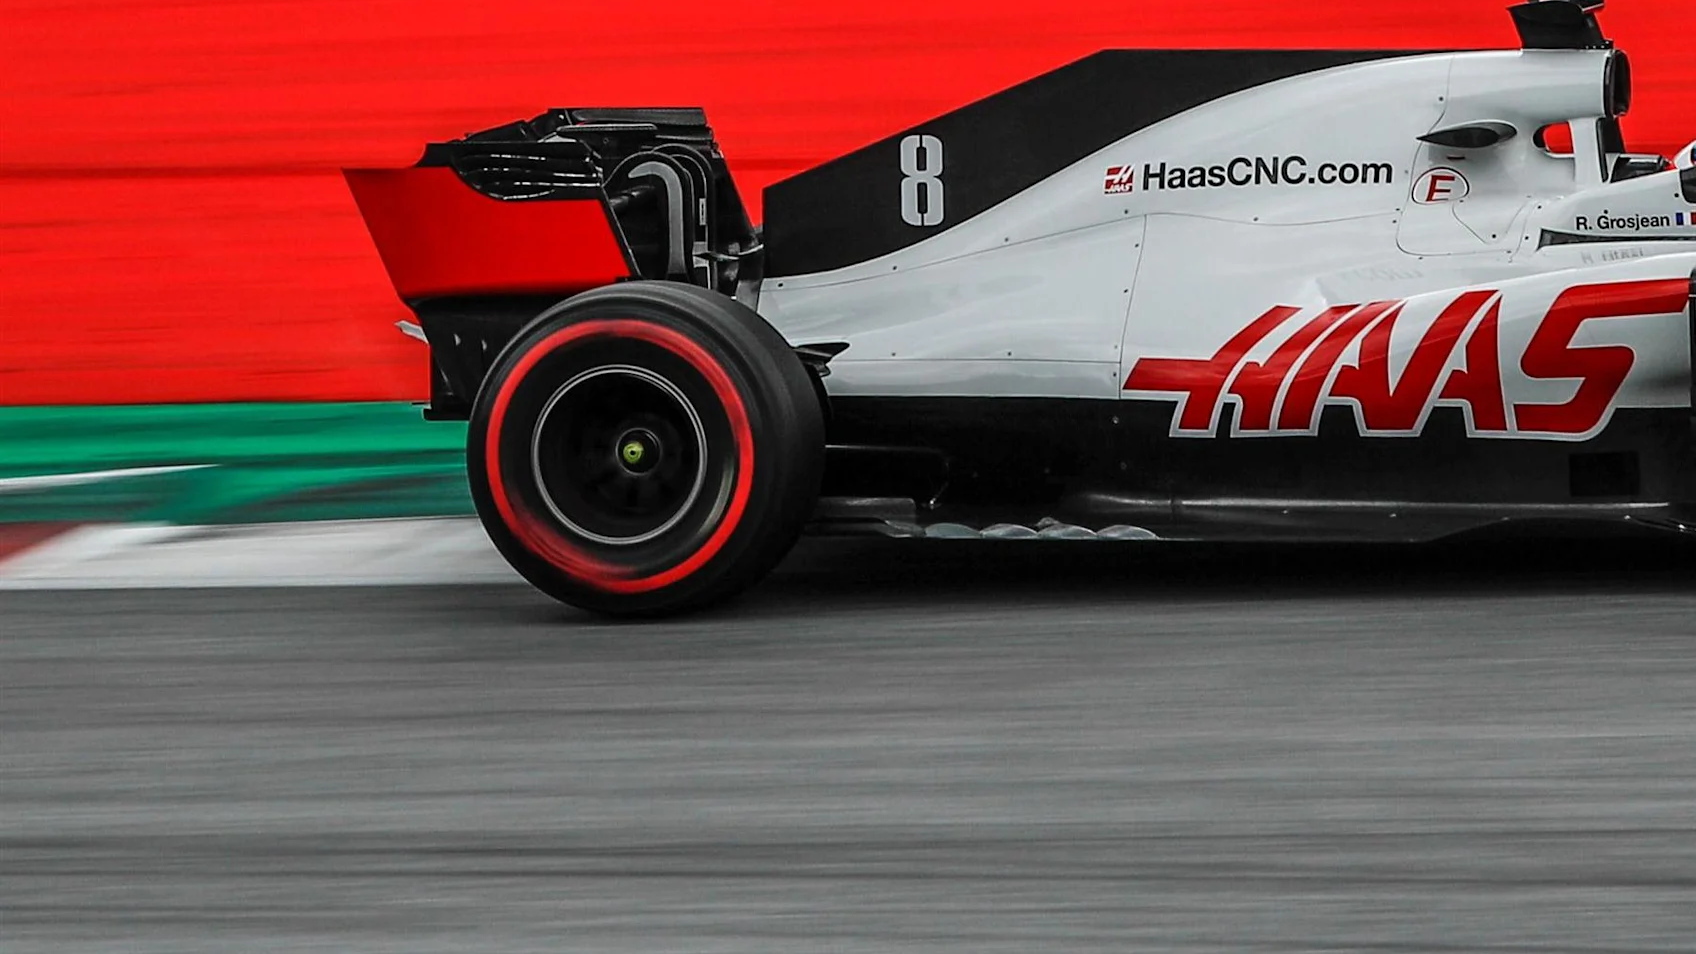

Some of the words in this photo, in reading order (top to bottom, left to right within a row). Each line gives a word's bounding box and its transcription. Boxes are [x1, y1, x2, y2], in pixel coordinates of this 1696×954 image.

[900, 134, 945, 226] 8
[1142, 155, 1393, 191] HaasCNC.com
[1425, 173, 1456, 202] E
[1576, 216, 1593, 231] R.
[1596, 213, 1671, 231] Grosjean
[1122, 277, 1690, 441] HAAS
